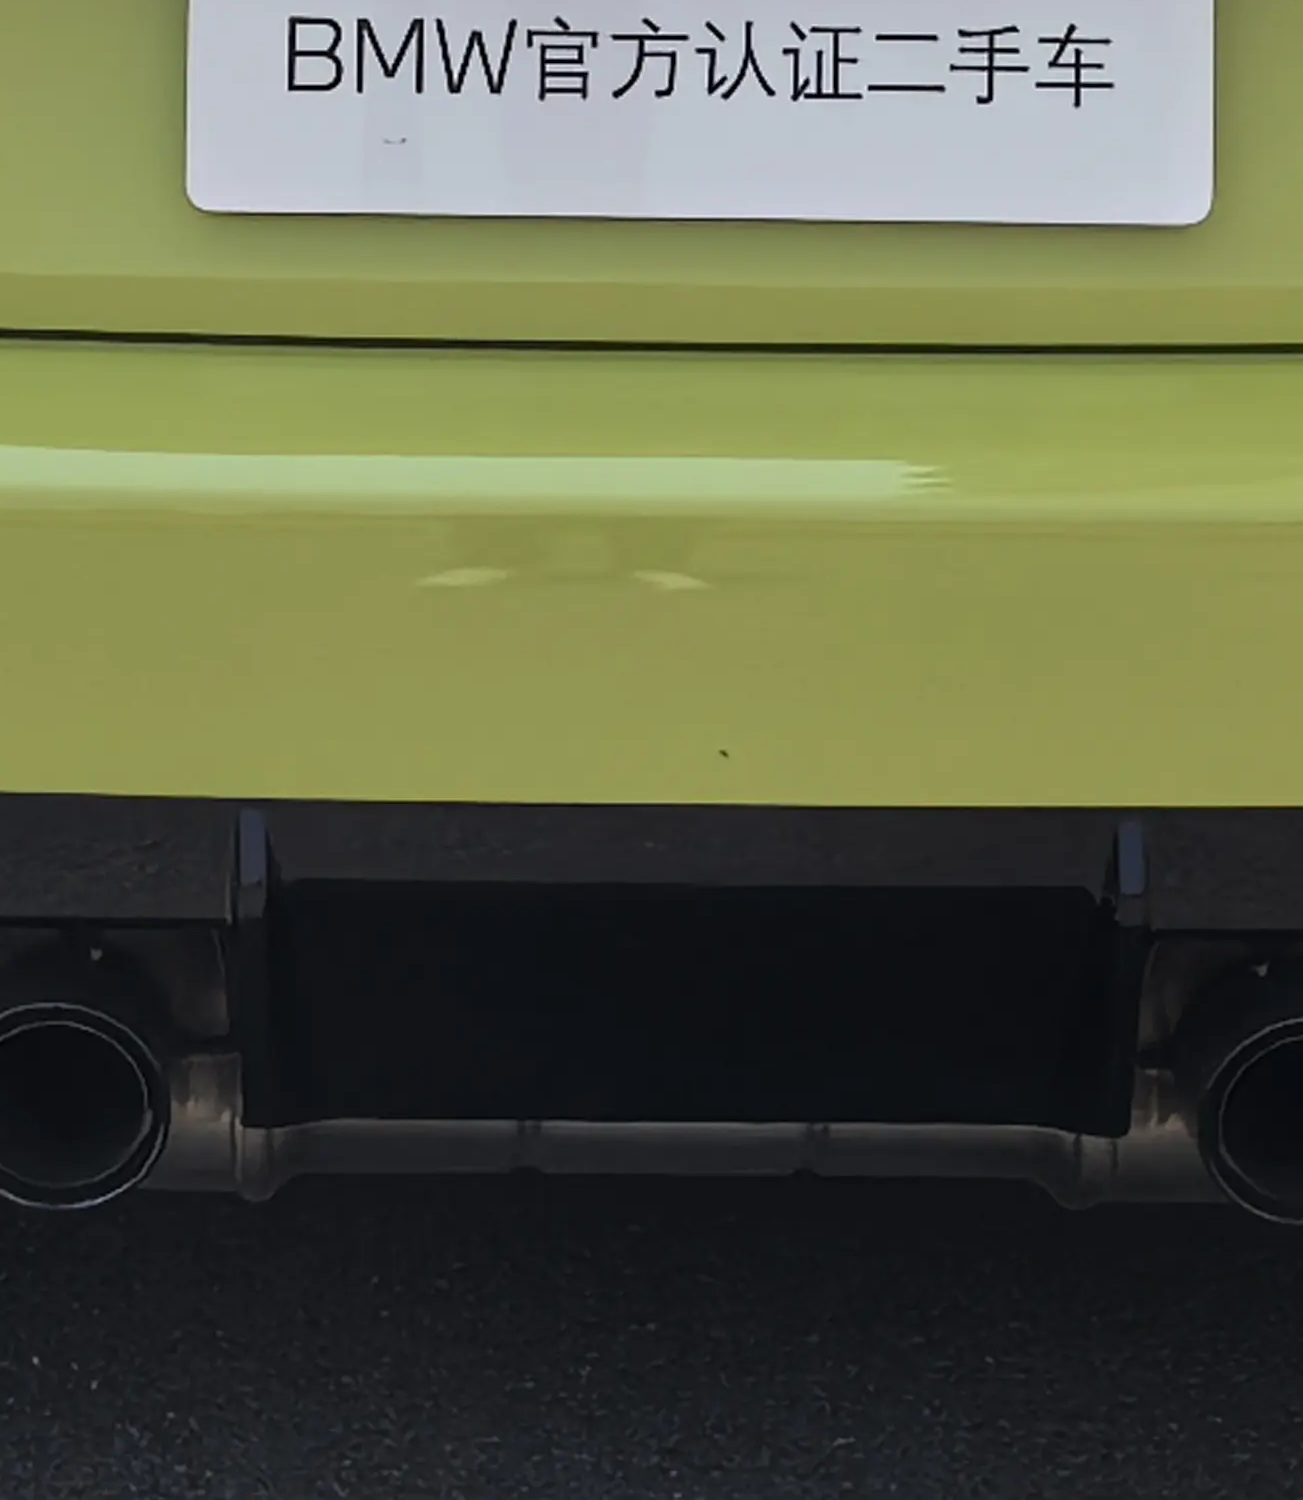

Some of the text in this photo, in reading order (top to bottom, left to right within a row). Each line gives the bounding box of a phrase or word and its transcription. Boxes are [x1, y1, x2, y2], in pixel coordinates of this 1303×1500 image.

[286, 15, 1116, 109] BMW官方认证二手车
